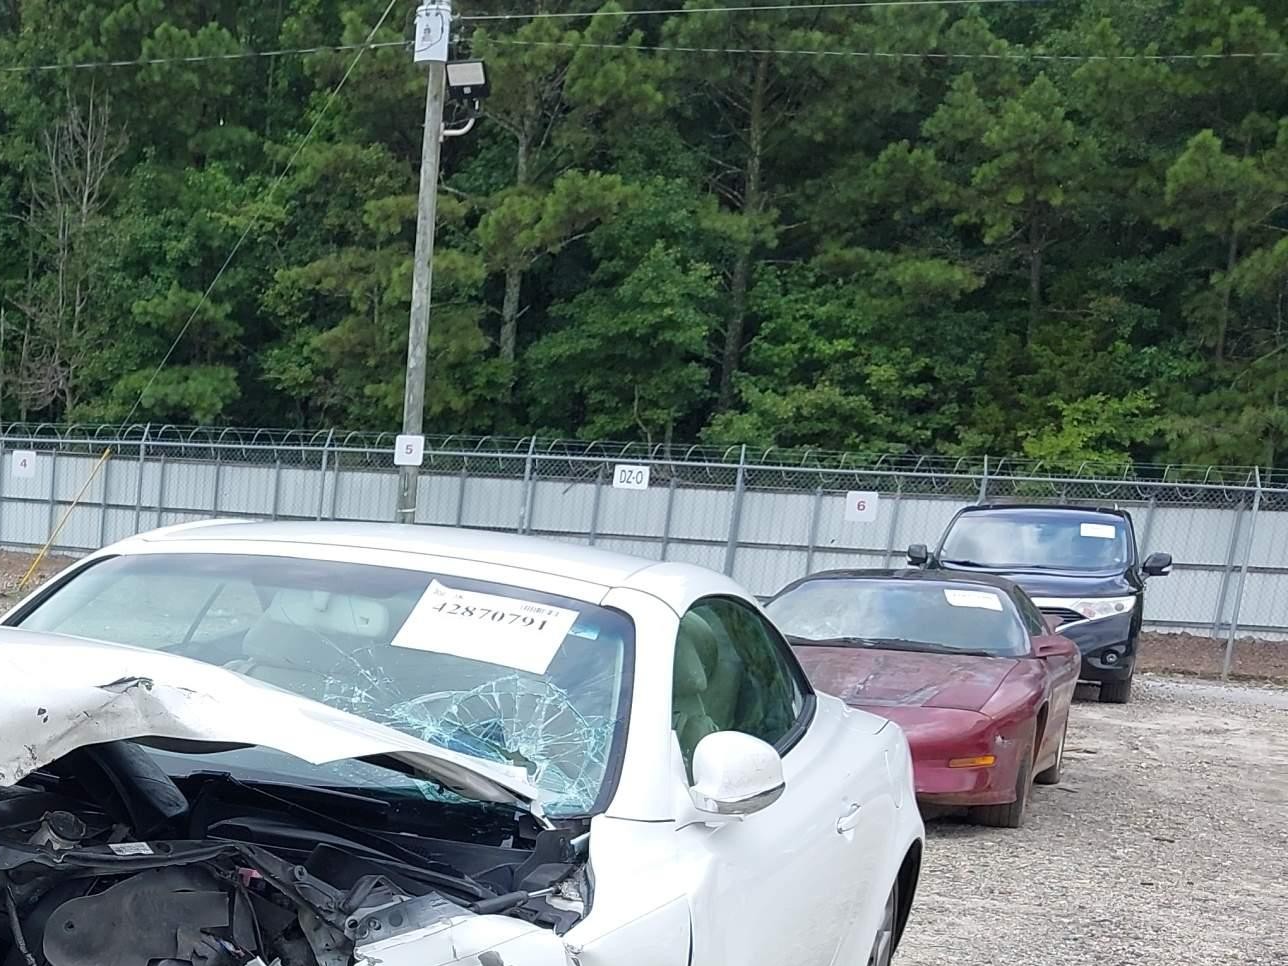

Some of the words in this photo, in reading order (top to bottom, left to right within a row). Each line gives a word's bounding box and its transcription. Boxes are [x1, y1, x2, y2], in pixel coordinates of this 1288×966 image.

[405, 444, 414, 455] 5
[20, 458, 27, 468] 4
[857, 500, 866, 511] 6
[431, 602, 548, 631] 42870791
